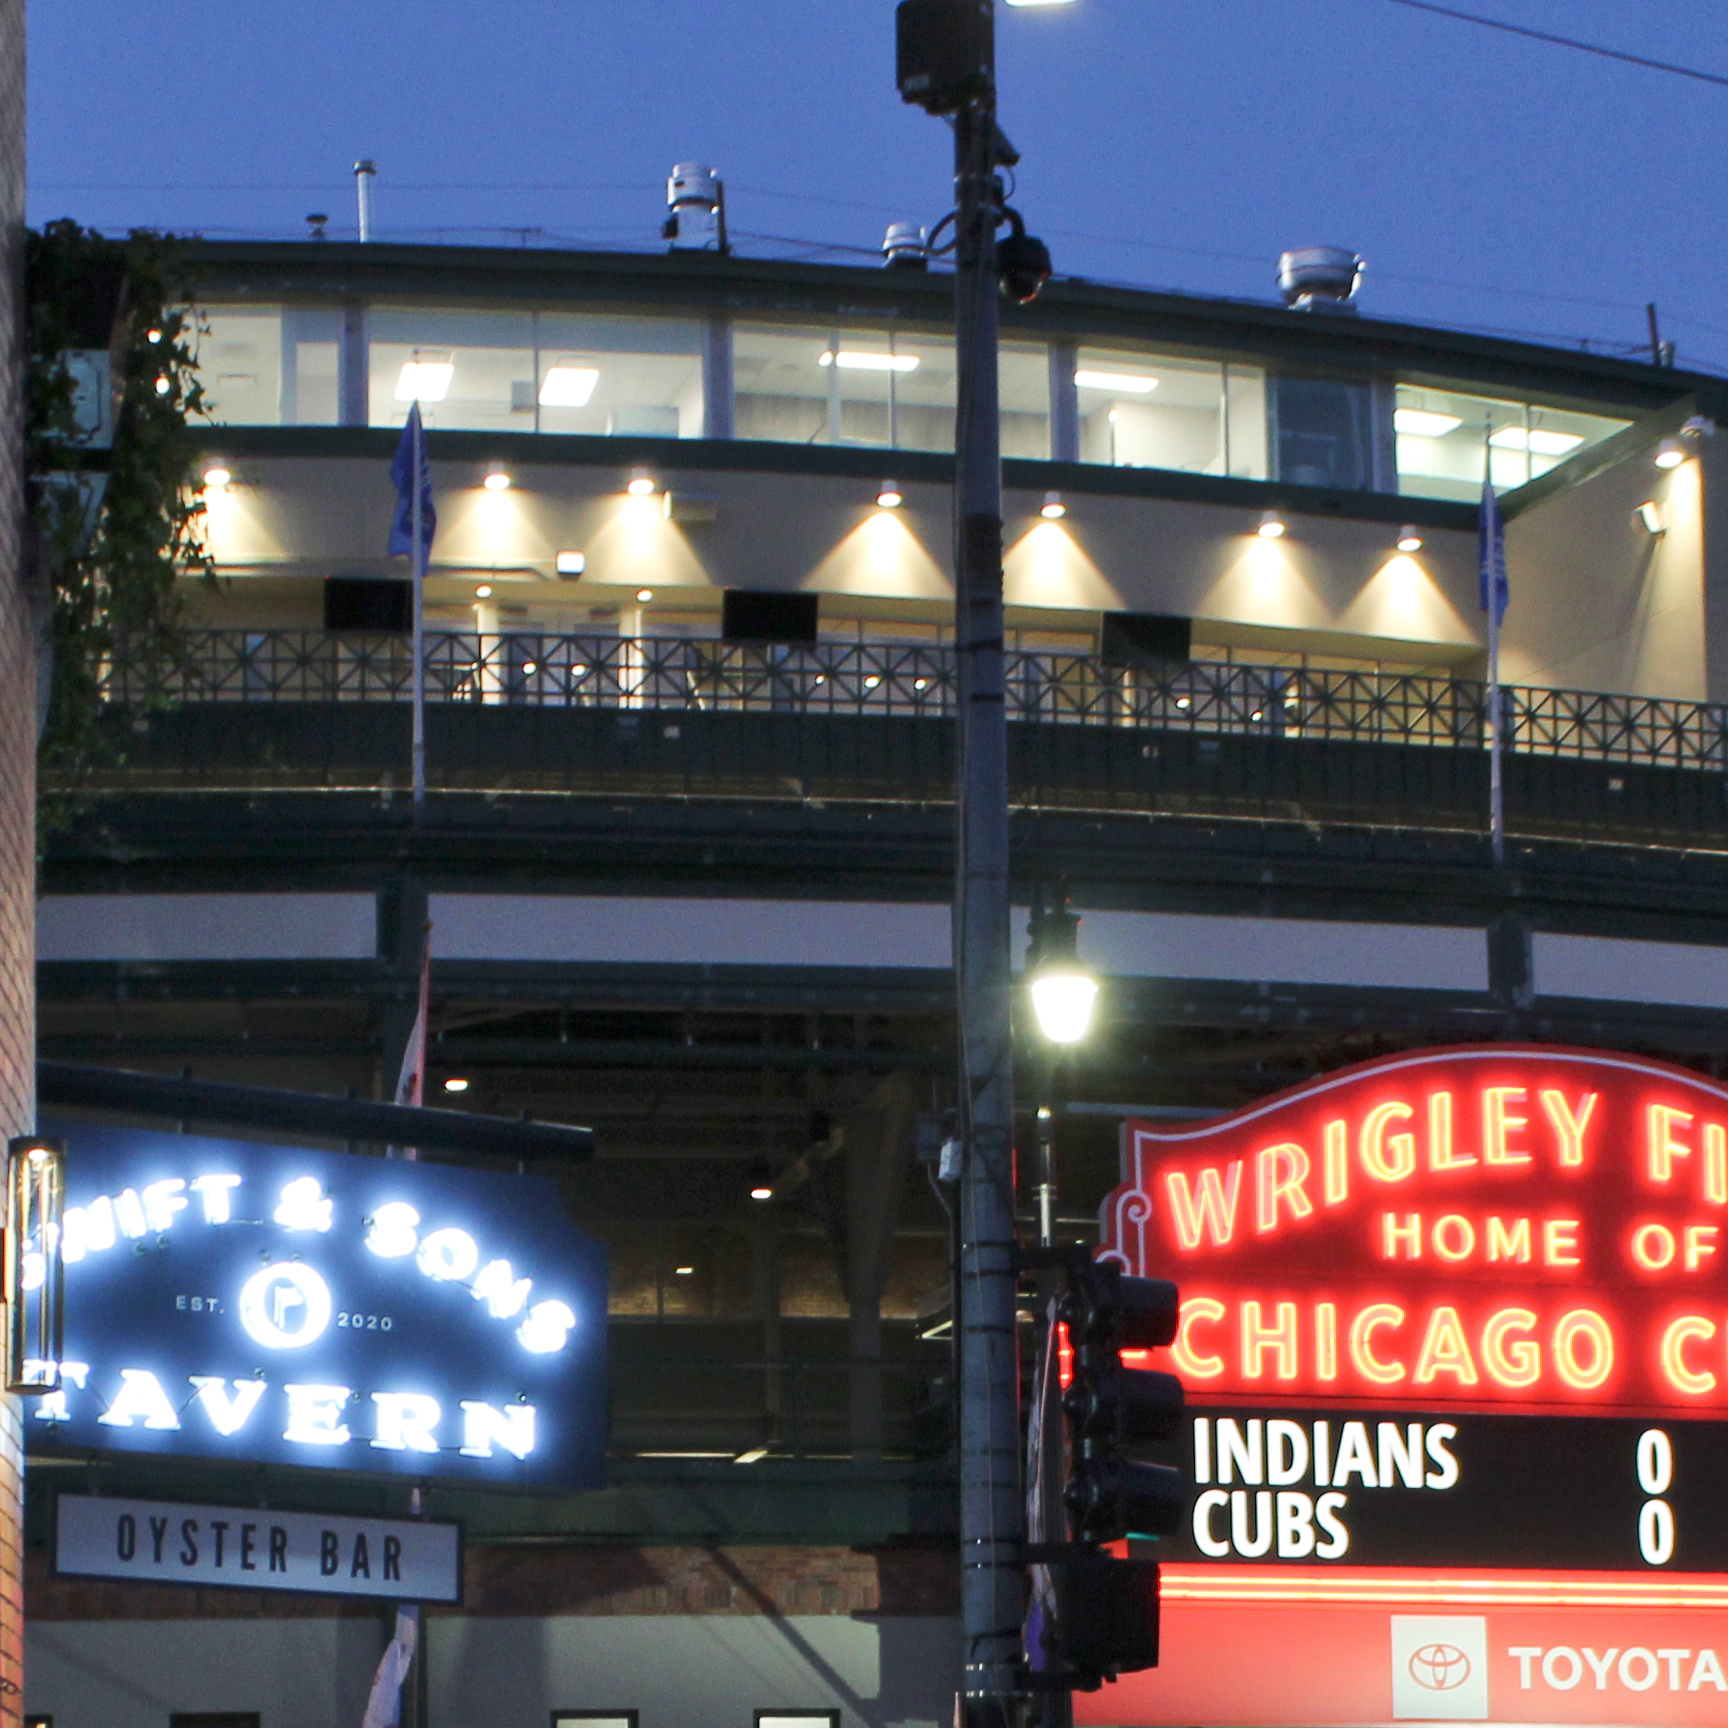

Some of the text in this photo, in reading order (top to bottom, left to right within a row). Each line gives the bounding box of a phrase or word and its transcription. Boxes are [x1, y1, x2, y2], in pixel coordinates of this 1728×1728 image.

[1164, 1084, 1599, 1252] WRIGLEY
[274, 1176, 333, 1233] &
[364, 1201, 576, 1354] SONS
[1381, 1211, 1720, 1271] HOME OF
[337, 1311, 393, 1331] 2020
[1171, 1297, 1615, 1389] CHICAGO
[22, 1358, 536, 1460] TAVERN
[1193, 1418, 1673, 1494] INDIANS 0
[116, 1513, 403, 1582] OYSTER BAR
[1191, 1490, 1674, 1565] CUBS 0
[1508, 1646, 1728, 1693] TOYOTA
